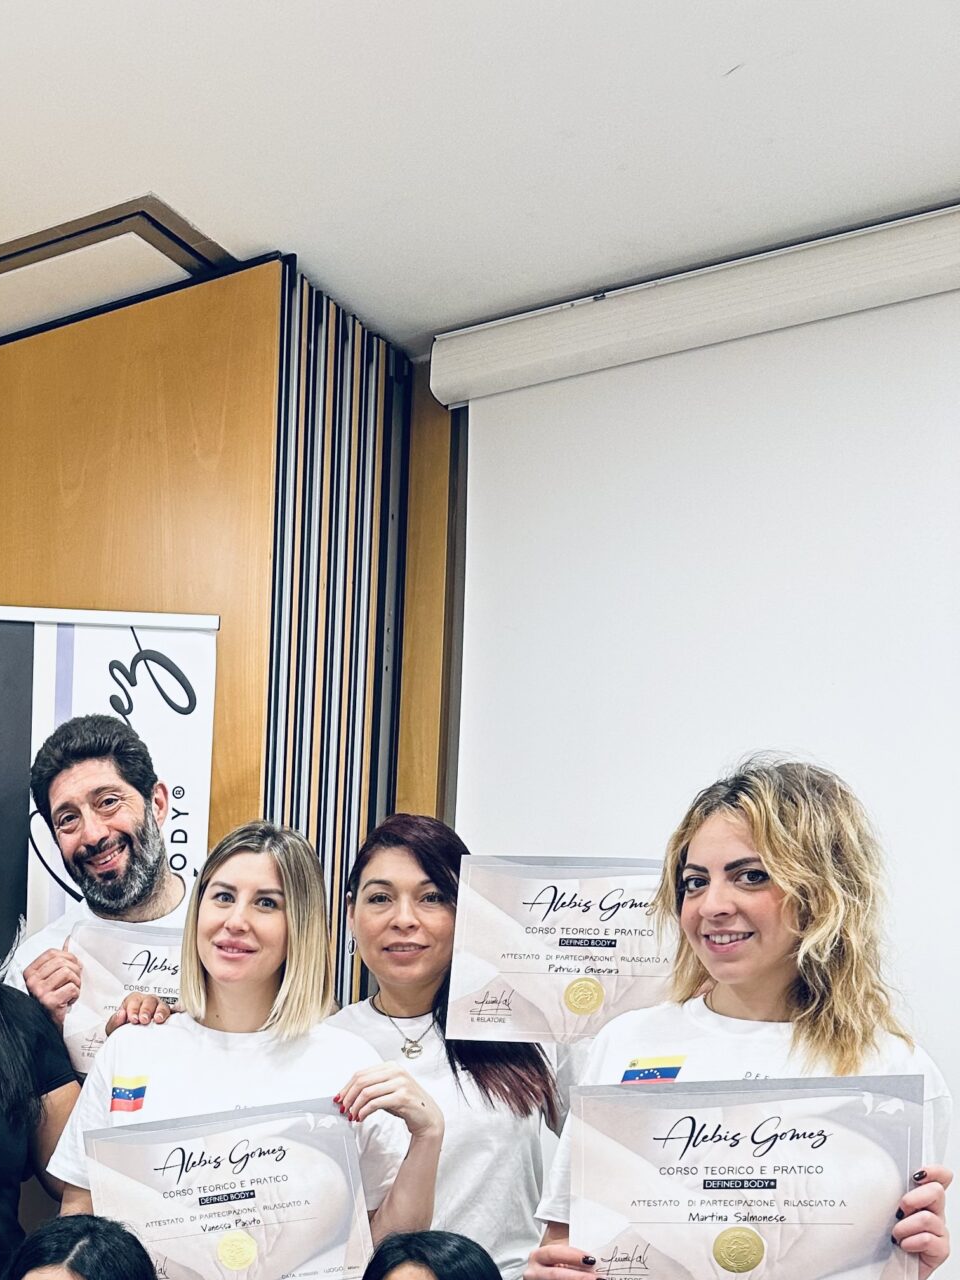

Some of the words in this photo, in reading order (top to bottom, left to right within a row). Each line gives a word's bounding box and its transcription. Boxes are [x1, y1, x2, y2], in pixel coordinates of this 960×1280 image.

[522, 885, 592, 922] Alebis
[598, 888, 657, 921] Gomez
[524, 926, 557, 935] CORSO
[560, 927, 600, 936] TEORICO
[603, 928, 611, 936] E
[613, 928, 654, 937] PRATICO
[560, 938, 590, 946] DEFINED
[555, 954, 614, 962] PARTECIPAZIONE
[122, 950, 180, 981] Alebis
[124, 984, 150, 993] CORSO
[154, 986, 180, 995] TEORIC
[652, 1115, 742, 1160] Alebis
[750, 1116, 827, 1157] Gomez
[153, 1147, 222, 1184] Alebis
[228, 1139, 286, 1174] Gomez
[658, 1166, 699, 1176] CORSO
[703, 1166, 755, 1175] TEORICO
[759, 1165, 768, 1175] E
[772, 1165, 824, 1175] PRATICO
[162, 1187, 195, 1199] CORSO
[197, 1181, 237, 1194] TEORICO
[239, 1180, 247, 1188] E
[249, 1174, 289, 1187] PRATICO
[705, 1180, 742, 1188] DEFINED
[200, 1194, 230, 1205] DEFINED
[630, 1199, 680, 1207] ATTESTATO
[687, 1199, 696, 1207] DI
[700, 1199, 775, 1207] PARTECIPAZIONE
[783, 1199, 835, 1207] RILASCIATO
[144, 1216, 185, 1228] ATTESTATO
[199, 1206, 257, 1221] PARTECIPAZIONE
[262, 1200, 302, 1212] RILASCIATO
[733, 1211, 786, 1222] Salmonese
